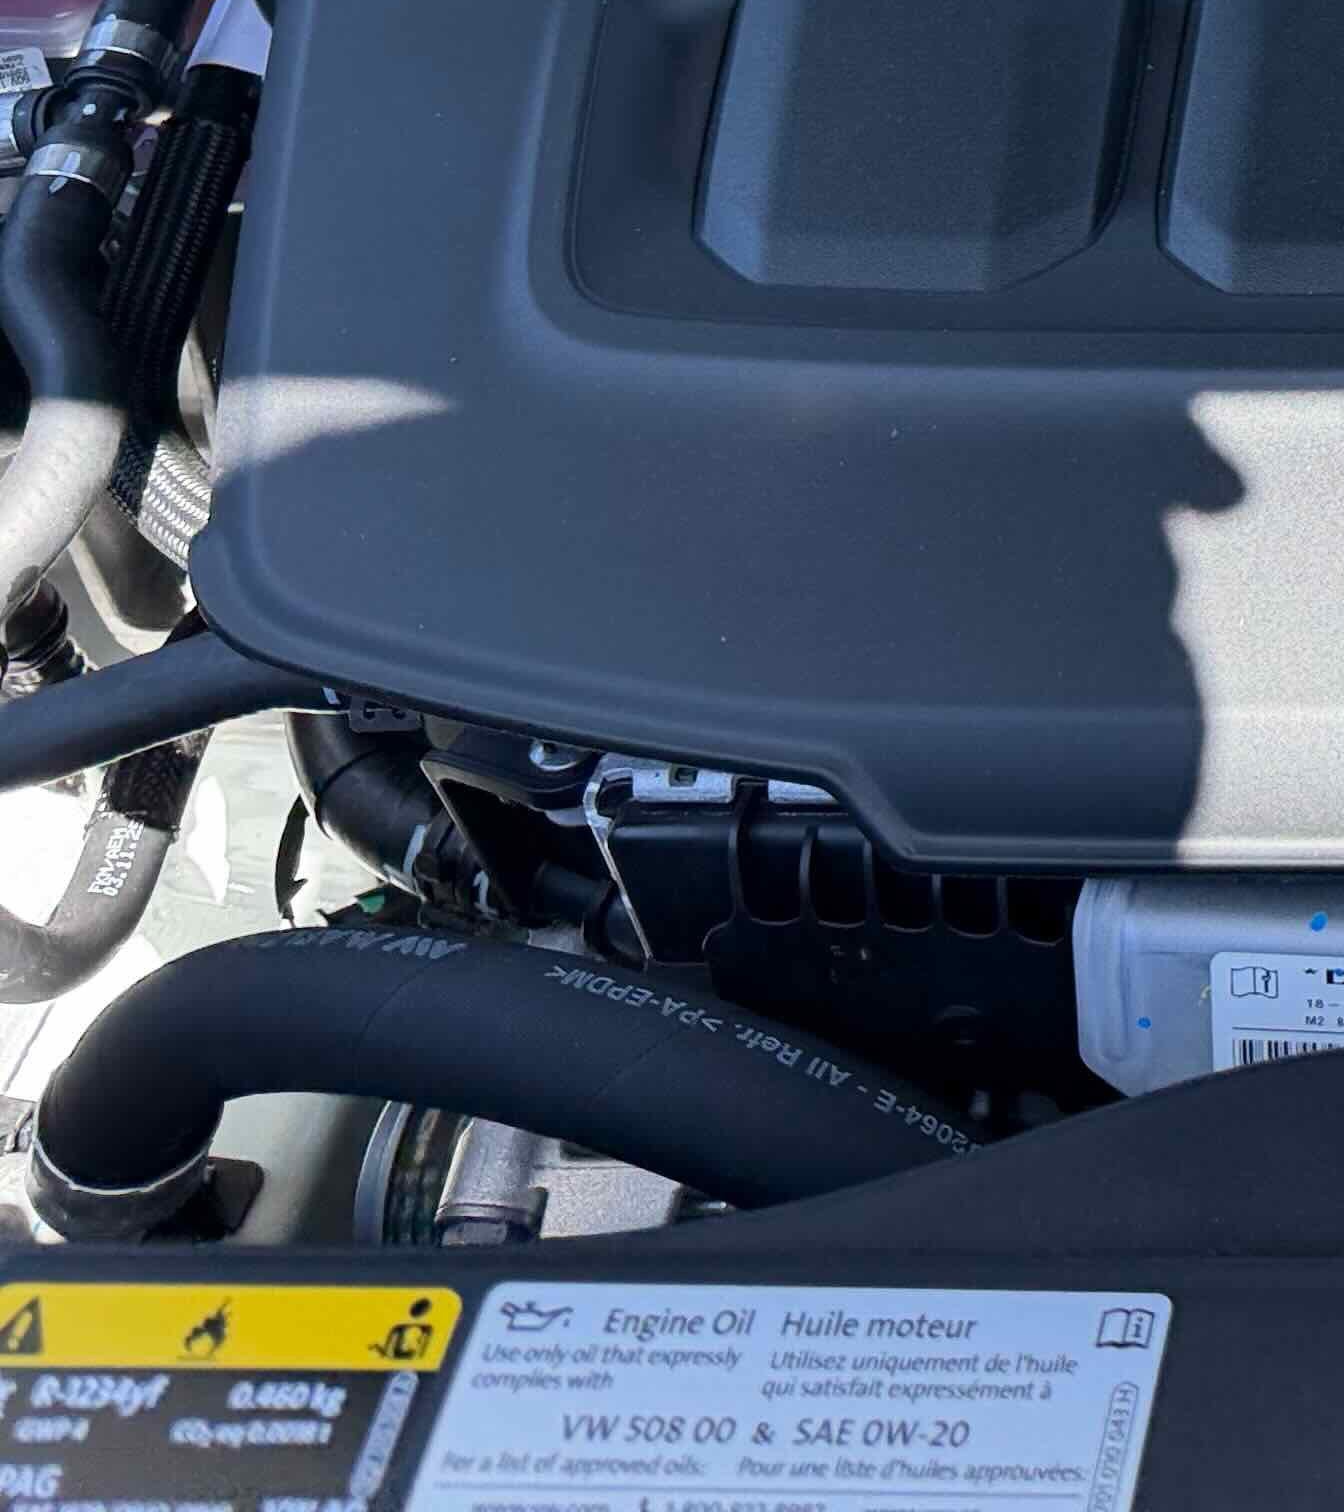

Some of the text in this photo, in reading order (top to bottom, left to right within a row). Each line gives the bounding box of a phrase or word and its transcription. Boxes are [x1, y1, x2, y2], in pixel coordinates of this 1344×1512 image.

[734, 1023, 803, 1068] Refr.
[804, 1057, 852, 1087] All
[603, 1308, 979, 1342] Engine Oil Huile moteur
[482, 1343, 742, 1372] Use only oil that expressly
[770, 1351, 1079, 1379] Utilisez uniquement de l'huile
[471, 1371, 615, 1393] complies with
[761, 1378, 1053, 1405] qui satisfait expressément à
[562, 1414, 971, 1448] VW 508 00 & SAE 0W-20
[441, 1451, 475, 1473] For
[496, 1451, 531, 1474] list
[533, 1451, 557, 1474] of
[559, 1453, 662, 1479] approved
[737, 1455, 785, 1477] Pour
[788, 1460, 830, 1478] une
[834, 1456, 876, 1479] liste
[879, 1456, 960, 1480] d'huiles
